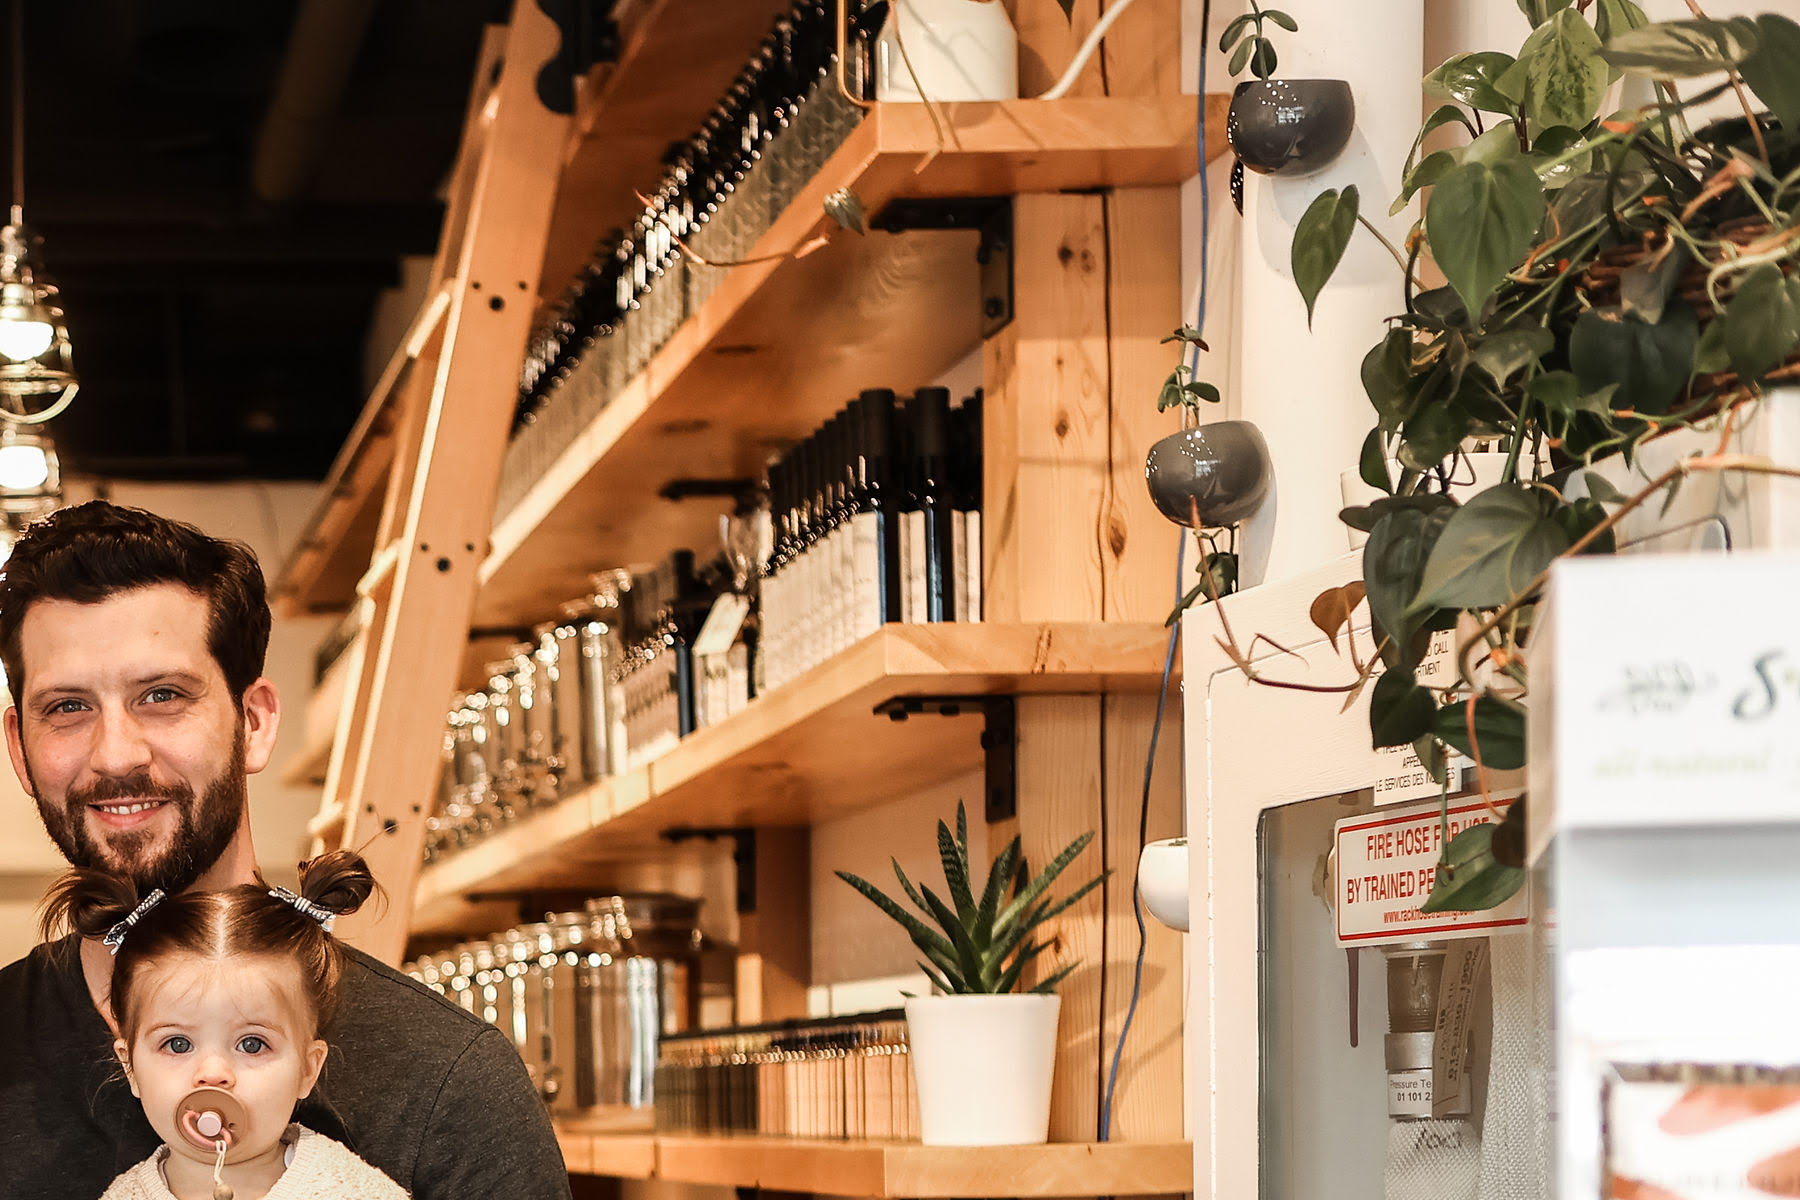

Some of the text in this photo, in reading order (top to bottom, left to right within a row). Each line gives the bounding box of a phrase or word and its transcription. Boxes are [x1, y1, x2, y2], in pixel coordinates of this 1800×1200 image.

[1367, 832, 1393, 861] FIRE
[1396, 825, 1430, 857] HOSE
[1347, 877, 1362, 905] BY
[1364, 870, 1416, 901] TRAINED
